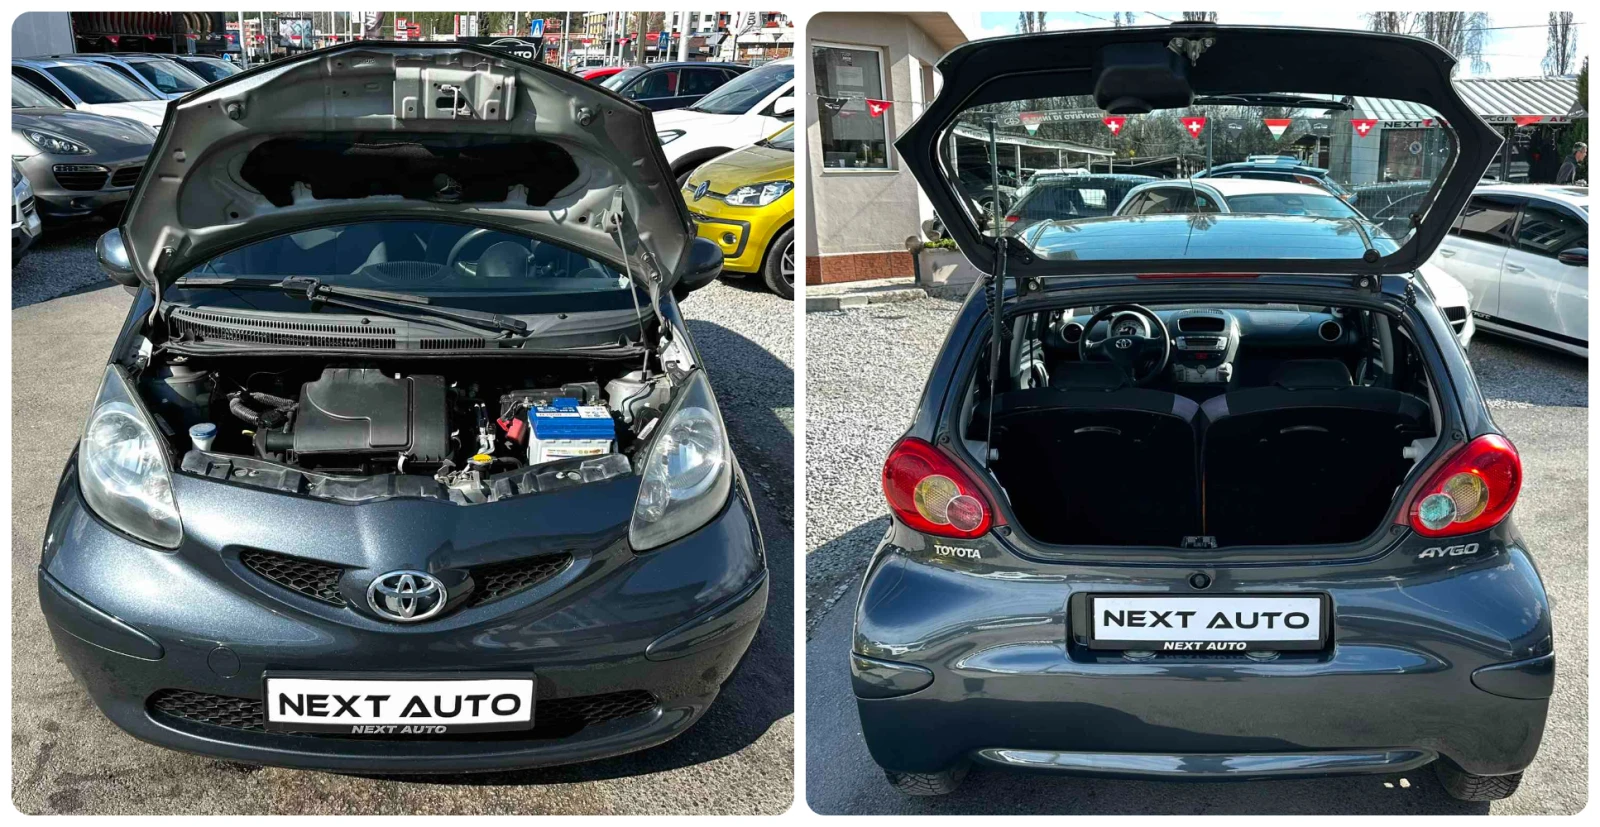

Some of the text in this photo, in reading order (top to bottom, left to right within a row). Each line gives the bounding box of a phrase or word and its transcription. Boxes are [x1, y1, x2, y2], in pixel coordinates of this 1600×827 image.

[933, 544, 982, 559] TOYOTA
[1418, 542, 1480, 559] AYGO
[1103, 609, 1310, 629] NEXT AUTO
[1163, 641, 1247, 650] NEXT AUTO
[279, 693, 521, 718] NEXT AUTO
[351, 725, 447, 734] NEXT AUTO
